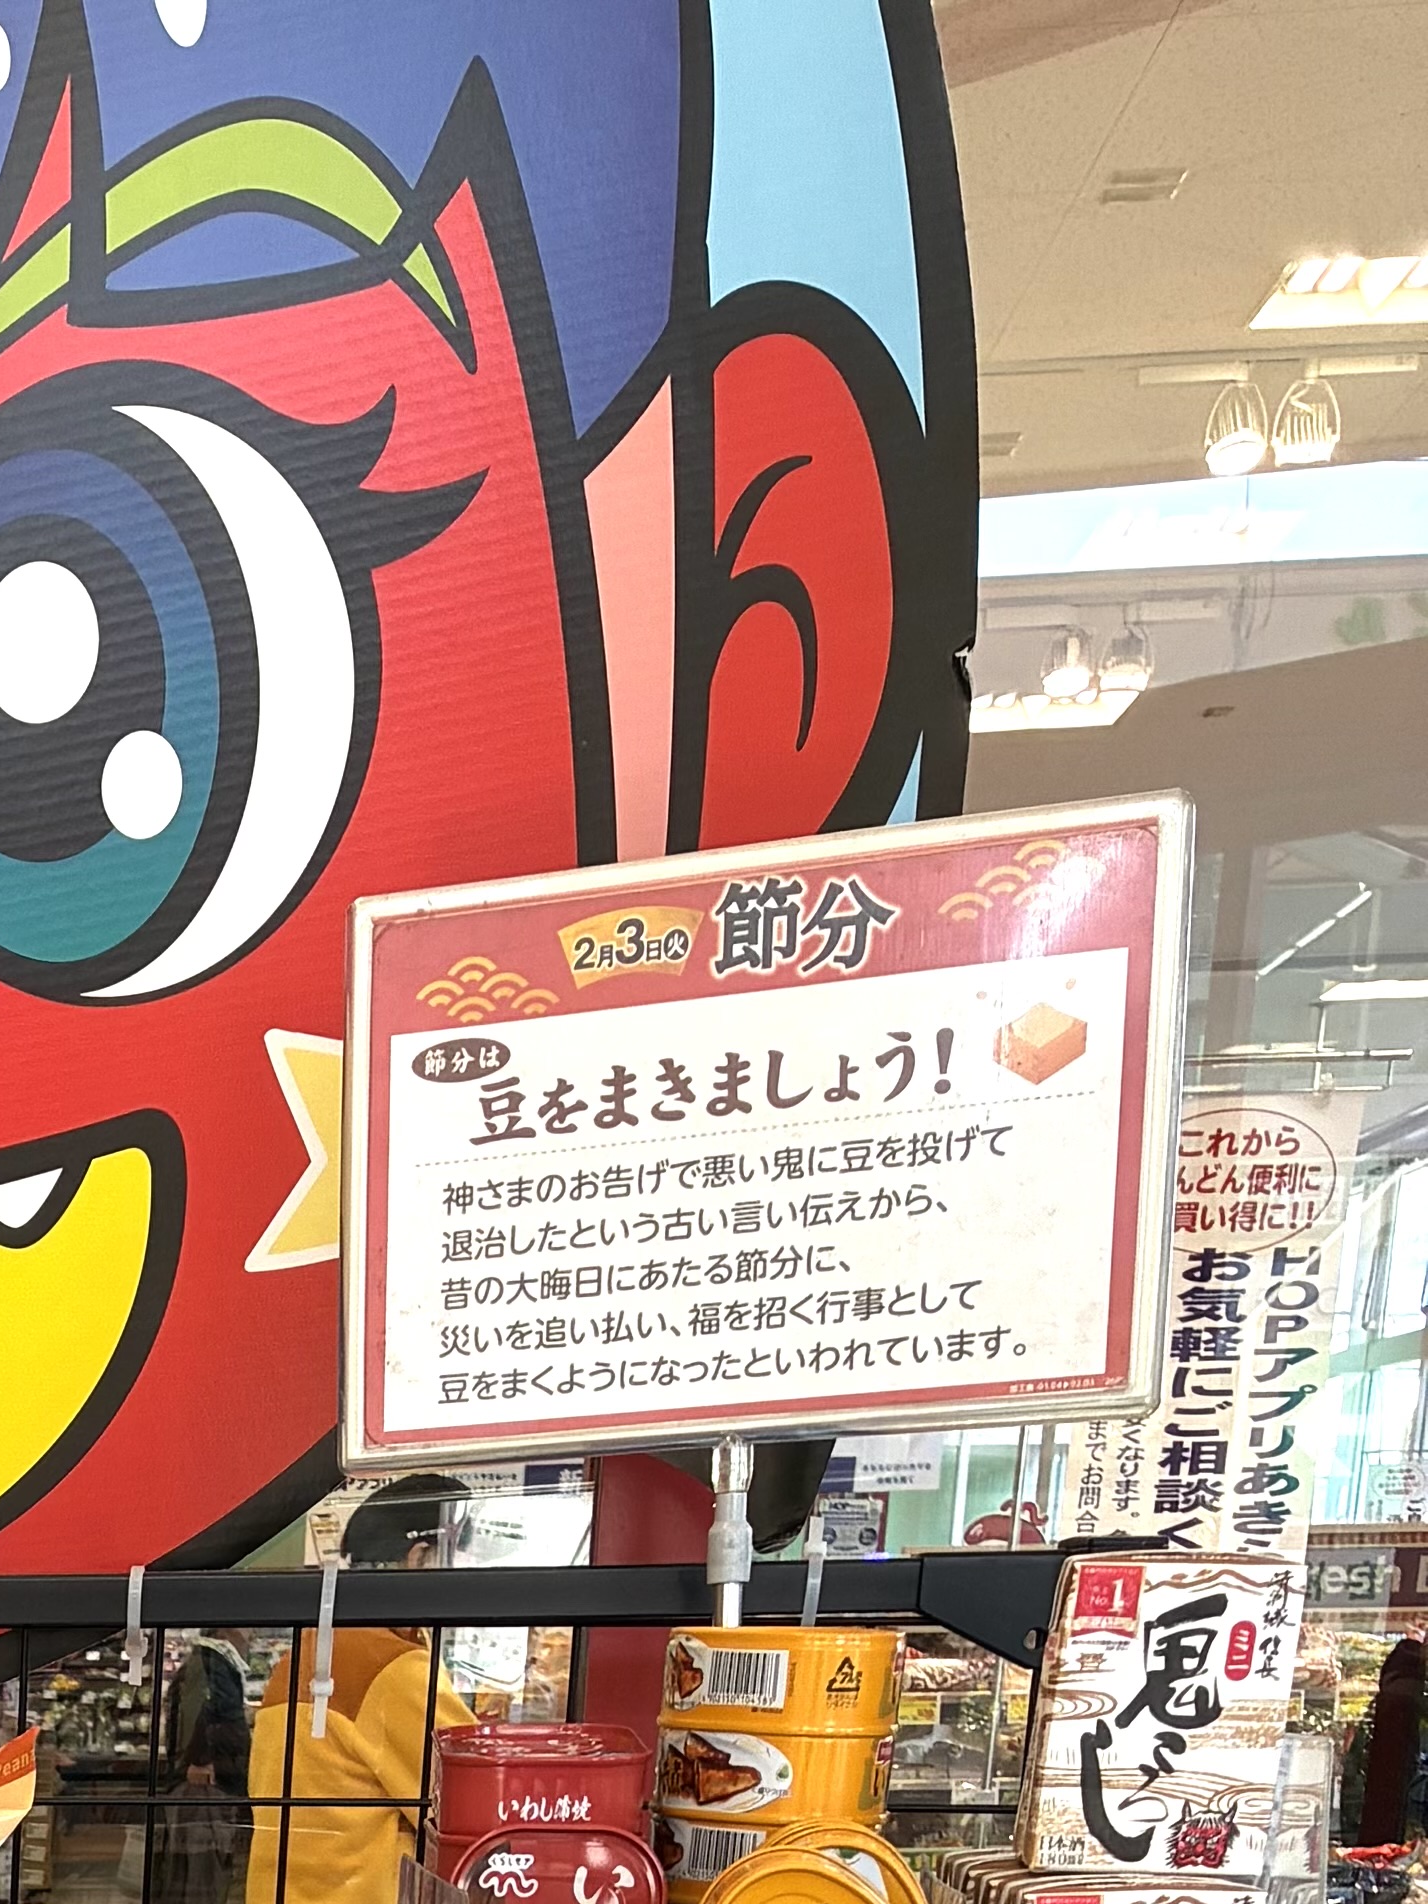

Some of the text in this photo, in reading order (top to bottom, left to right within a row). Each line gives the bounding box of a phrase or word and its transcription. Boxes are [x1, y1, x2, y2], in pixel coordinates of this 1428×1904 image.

[713, 878, 894, 977] 節分
[423, 1044, 500, 1076] 節分は
[442, 1123, 1014, 1215] 神さまのお告げで悪い鬼に豆を投げて
[442, 1185, 949, 1261] 退治したという古い言い伝えから、
[438, 1277, 979, 1357] 災いを追い払い、福を招く行事として
[440, 1246, 850, 1311] 昔の大晦日にあたる節分に、
[438, 1325, 1028, 1405] 豆をまくようになったといわれています。
[498, 1798, 591, 1823] いわし蒲焼
